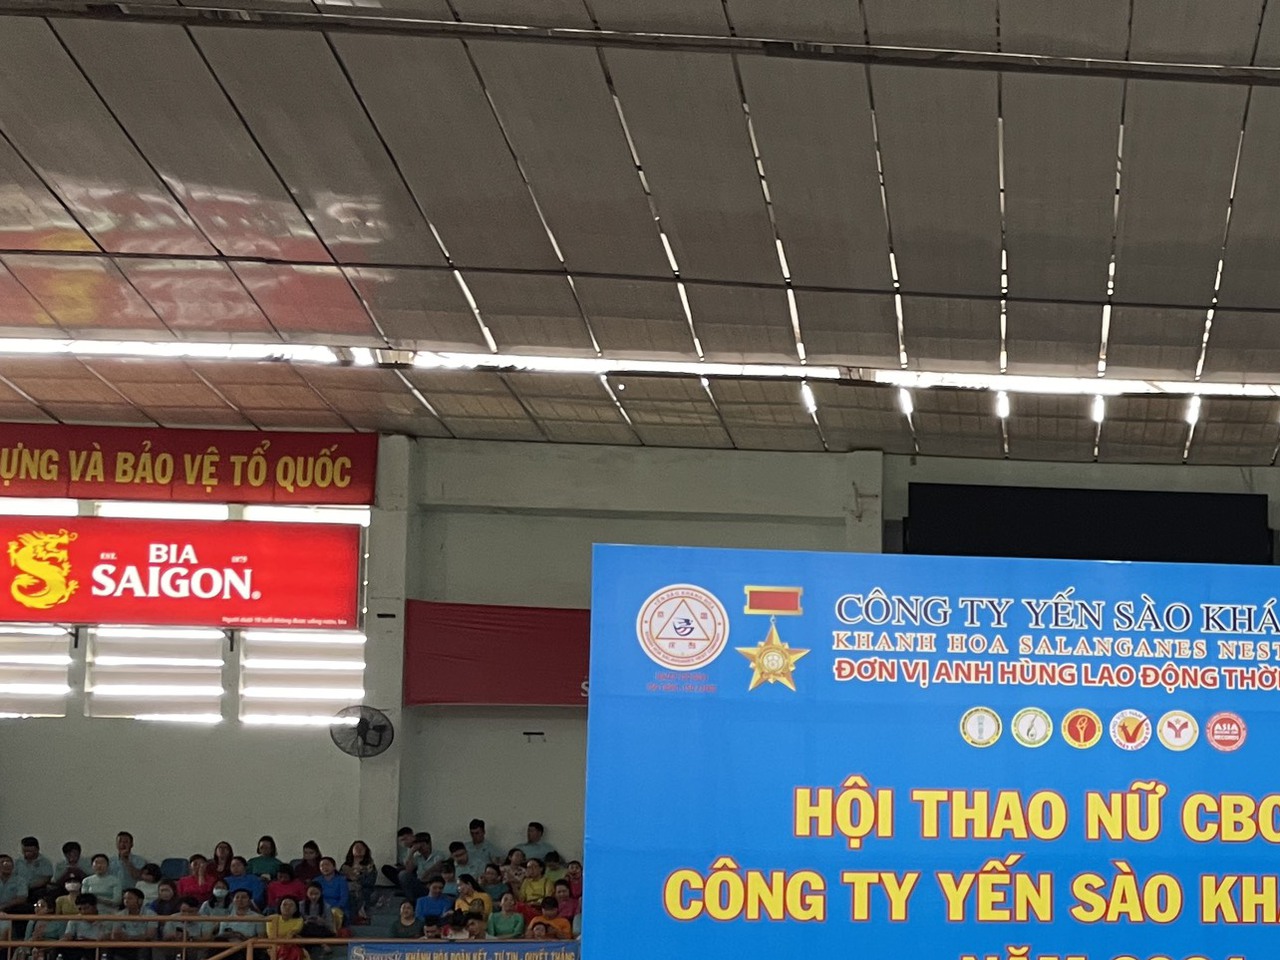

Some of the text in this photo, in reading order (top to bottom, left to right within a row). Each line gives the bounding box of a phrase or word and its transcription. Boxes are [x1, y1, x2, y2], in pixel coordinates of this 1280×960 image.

[68, 442, 104, 482] VÀ
[115, 440, 173, 485] BẢO
[184, 447, 219, 492] VỆ
[230, 440, 273, 488] TỔ
[276, 445, 352, 492] QUỐC
[149, 543, 198, 564] BIA
[835, 587, 951, 626] CÔNG
[959, 598, 1014, 628] TY
[1021, 586, 1105, 630] YẾN
[1113, 594, 1192, 632] SÀO
[832, 631, 936, 651] KHANH
[948, 634, 1008, 655] HOA
[1019, 635, 1207, 660] SALANGANES
[834, 658, 897, 681] ĐƠN
[901, 659, 929, 688] VỊ
[932, 661, 993, 684] ANH
[999, 657, 1076, 685] HÙNG
[1082, 664, 1135, 686] LAO
[1140, 663, 1218, 693] ĐỘNG
[1214, 723, 1238, 732] ASIA
[794, 774, 895, 849] HỘI
[910, 788, 1068, 840] THAO
[1085, 780, 1167, 842] NỮ
[663, 855, 827, 922] CÔNG
[841, 871, 920, 922] TY
[937, 853, 1053, 923] YẾN
[1070, 859, 1183, 924] SÀO
